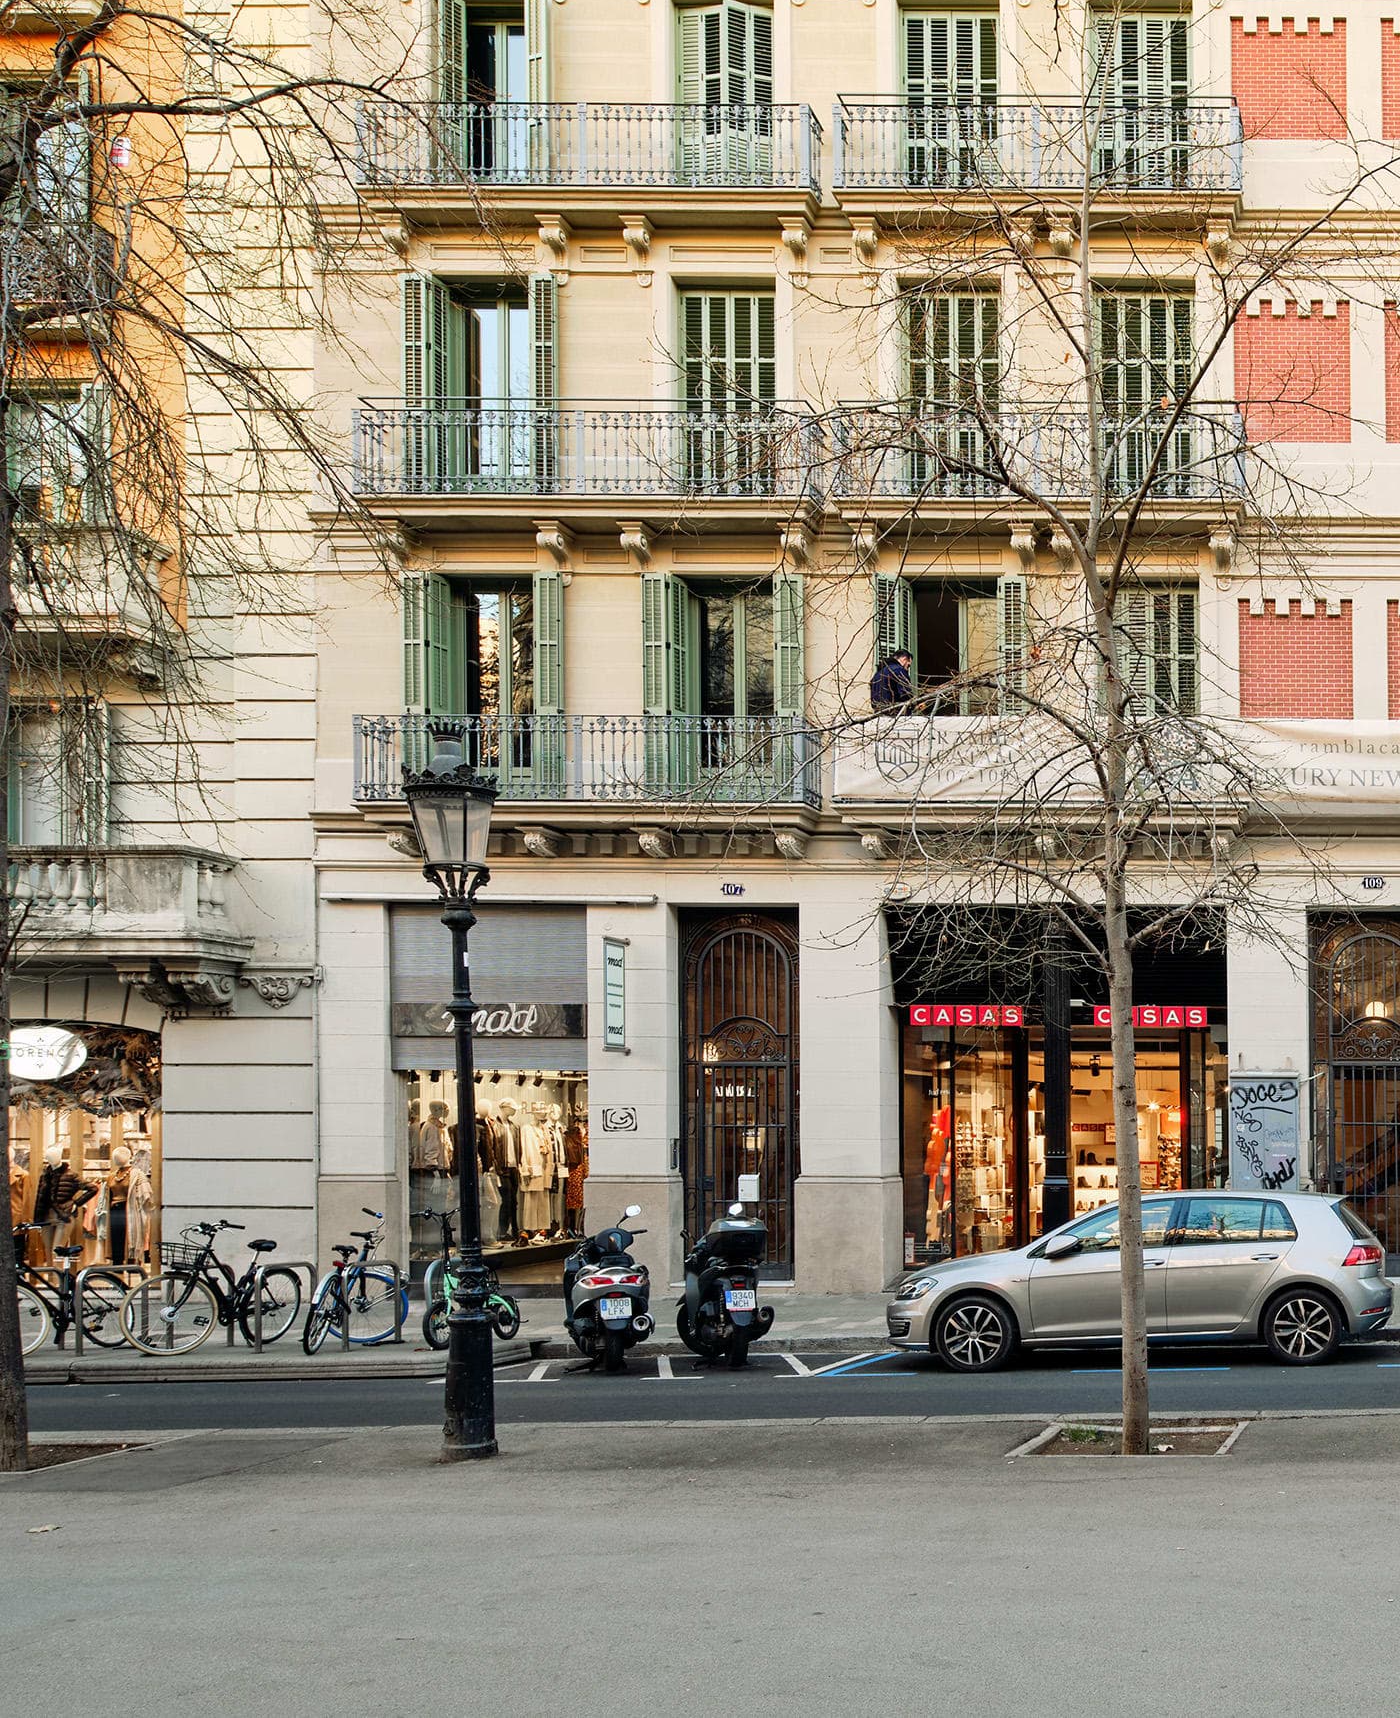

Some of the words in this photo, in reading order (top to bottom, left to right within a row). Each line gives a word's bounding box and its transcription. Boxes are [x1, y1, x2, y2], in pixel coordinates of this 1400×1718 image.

[1238, 768, 1345, 787] UXURY
[1365, 878, 1383, 888] 109
[724, 884, 742, 895] 107
[913, 1008, 1019, 1023] CASAS
[1097, 1009, 1203, 1024] CSAS
[731, 1291, 753, 1300] 9340
[609, 1299, 630, 1308] 1008
[732, 1299, 749, 1308] MCH
[608, 1307, 625, 1315] LFK
